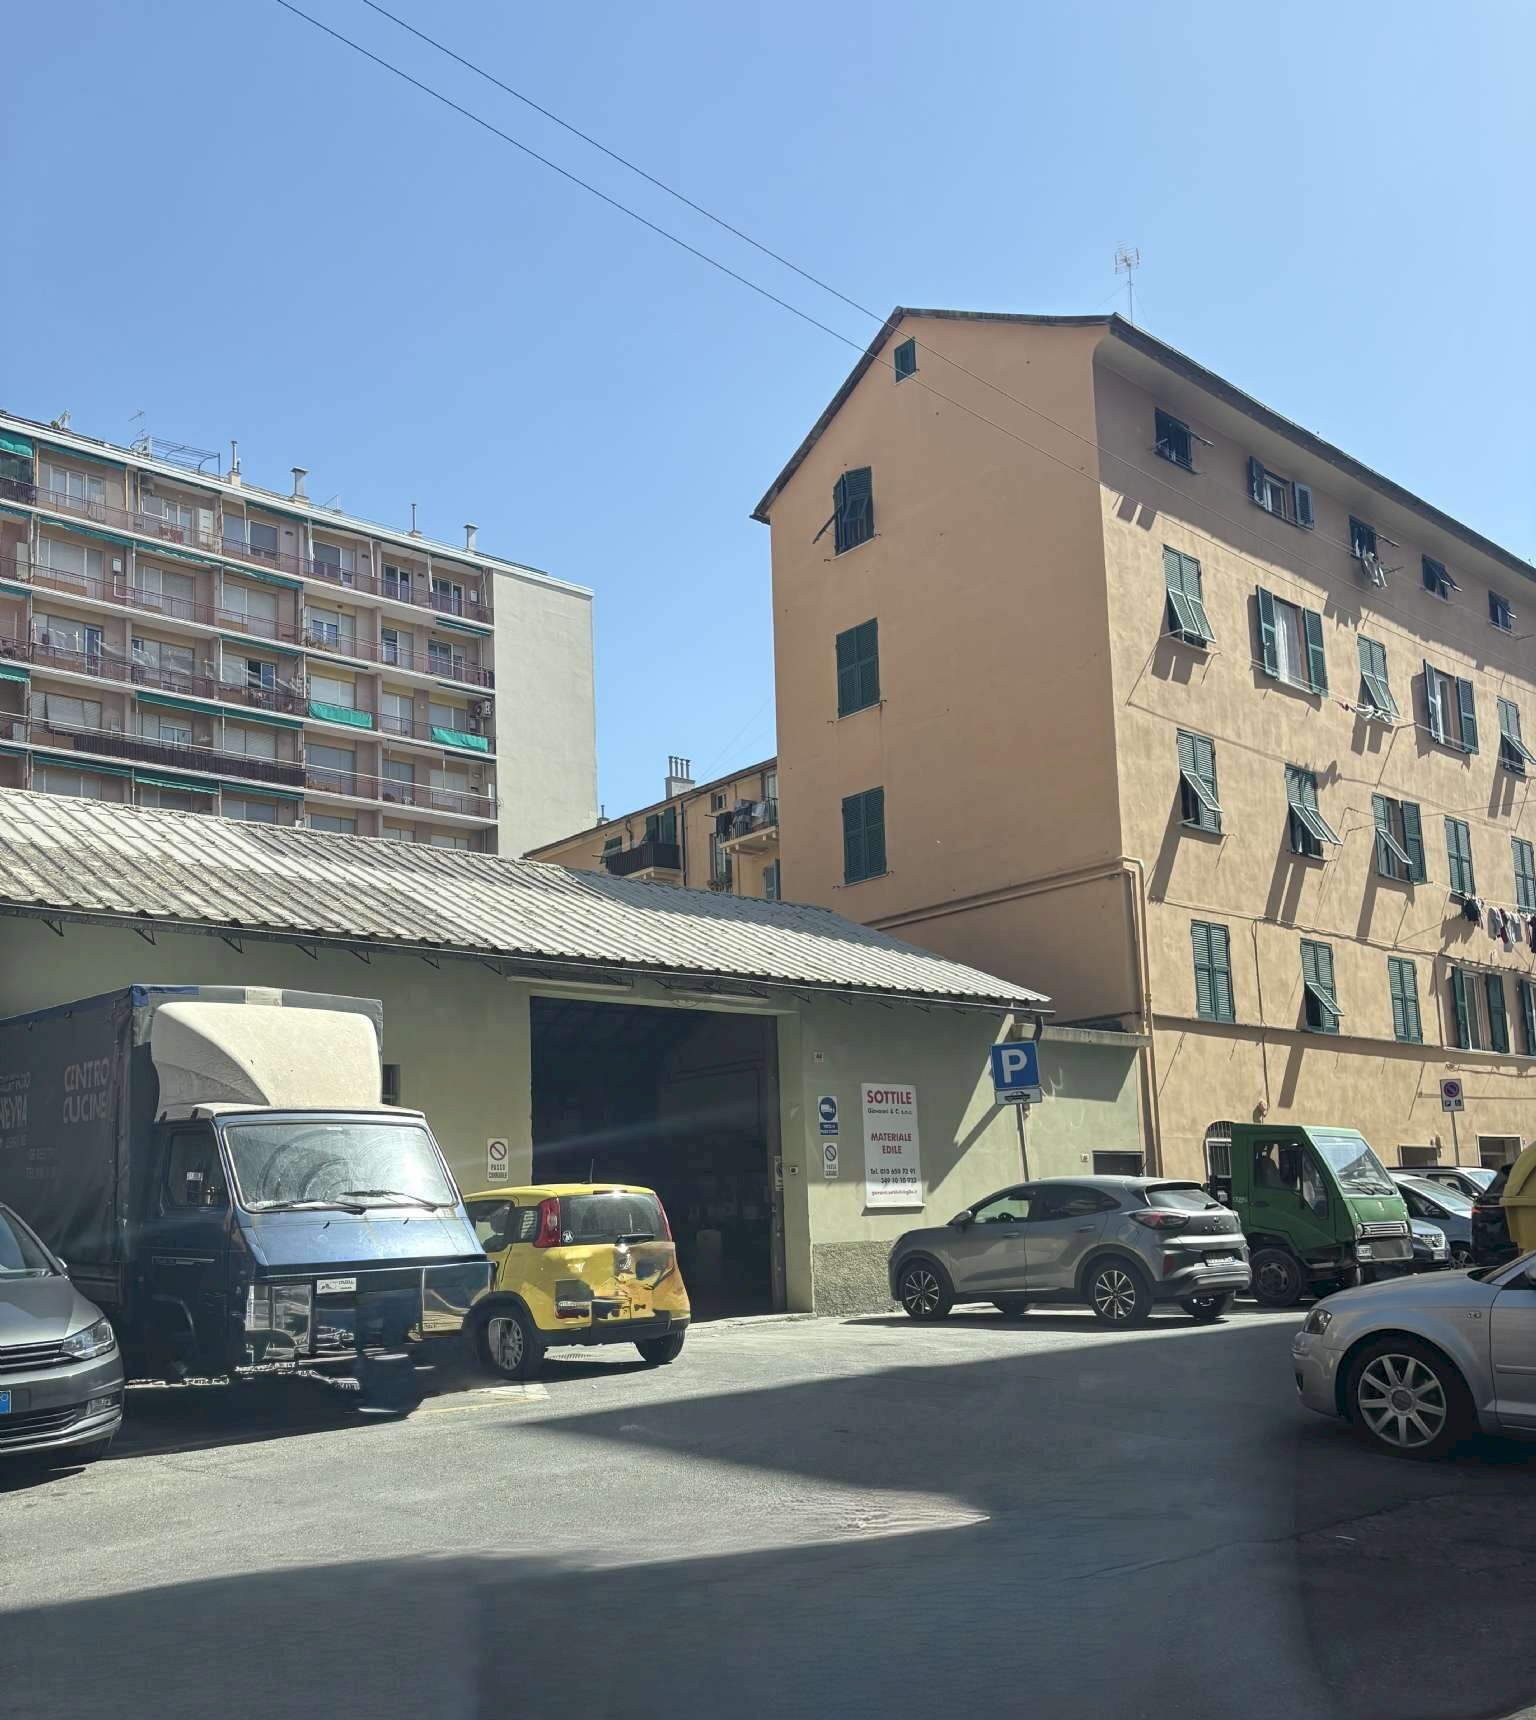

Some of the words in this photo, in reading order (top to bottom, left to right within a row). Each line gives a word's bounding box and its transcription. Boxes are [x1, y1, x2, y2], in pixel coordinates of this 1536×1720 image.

[1001, 1049, 1028, 1083] P
[64, 1058, 110, 1092] CENTRO
[867, 1090, 912, 1104] SOTTILE
[871, 1132, 912, 1142] MATERIALE
[882, 1145, 902, 1154] EDILE
